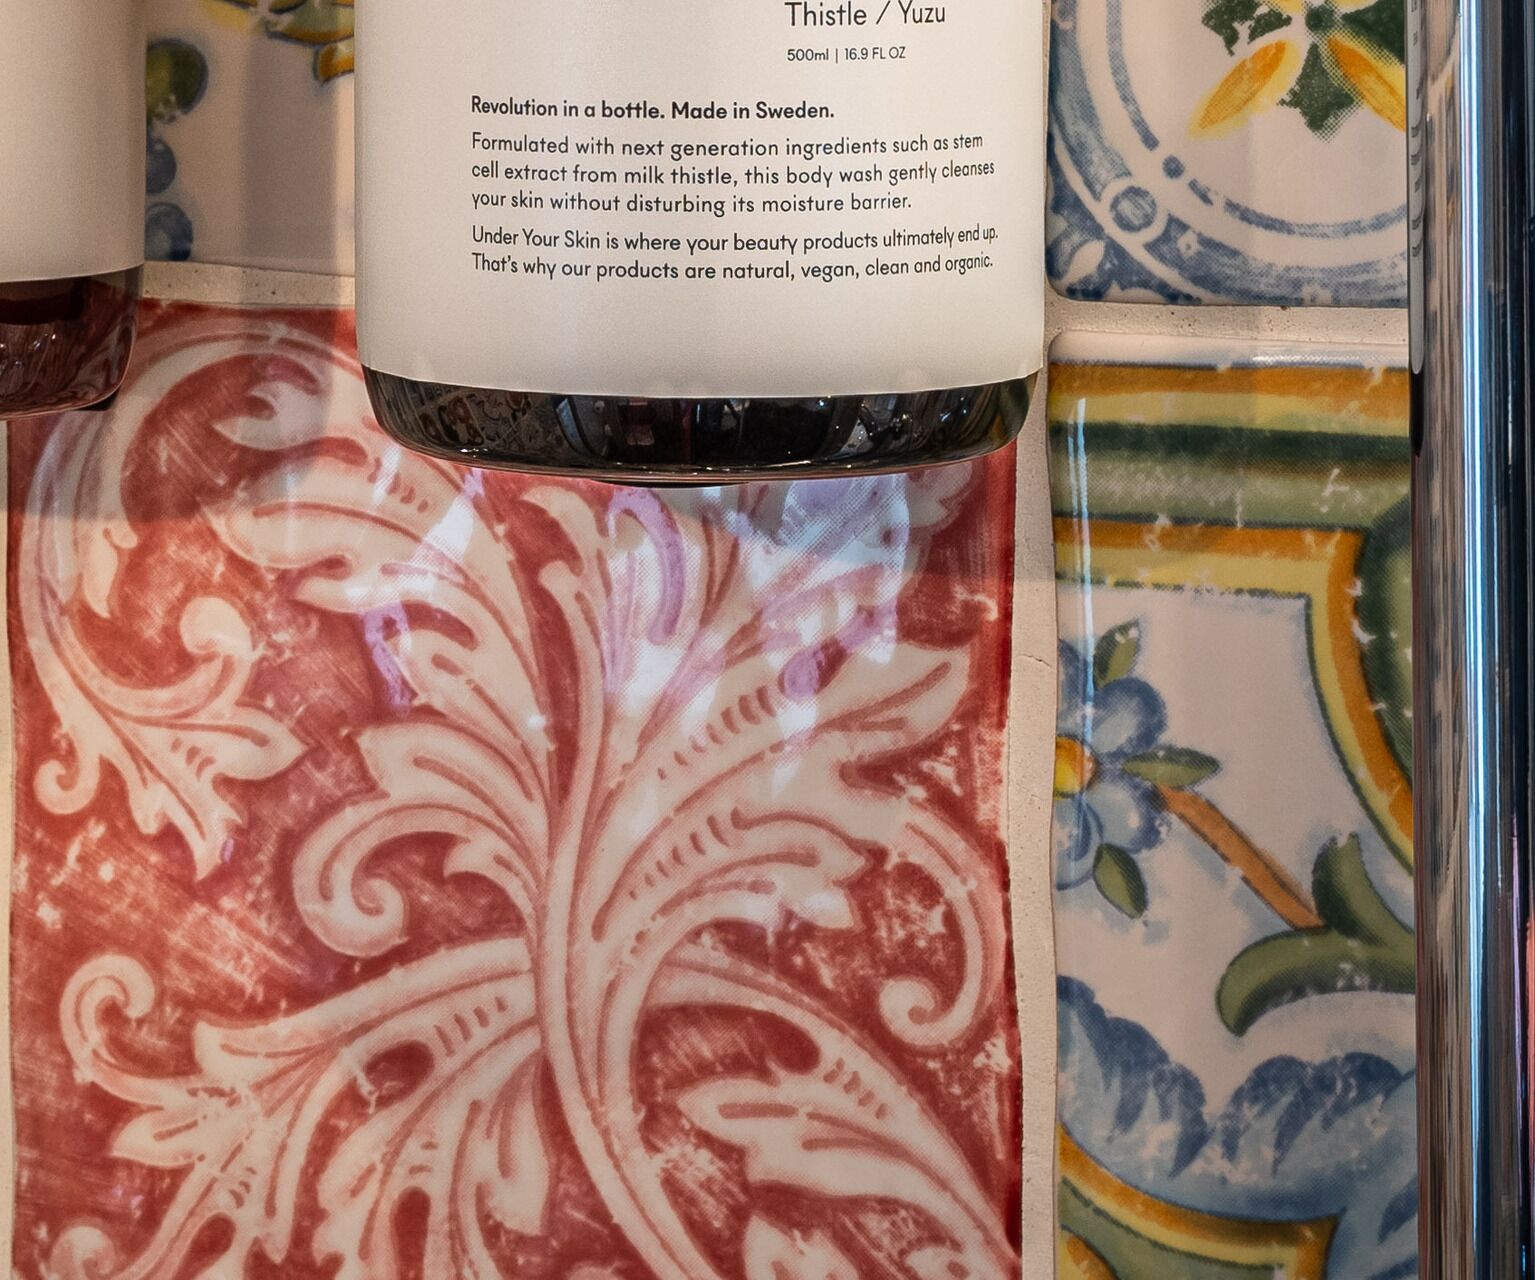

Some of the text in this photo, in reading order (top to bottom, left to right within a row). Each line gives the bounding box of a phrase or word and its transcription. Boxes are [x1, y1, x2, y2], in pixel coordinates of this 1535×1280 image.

[784, 0, 945, 26] Thistle / Yuzu
[787, 46, 906, 61] 500ml 16.9 FL OZ
[472, 95, 834, 119] Revolution in a bottle. Made in Sweden.
[472, 131, 887, 162] Formulated with next generation ingredients
[472, 160, 937, 188] cell extract from milk thistle, this body wash gently
[472, 189, 911, 218] your skin without disturbing its moisture barrier.
[473, 225, 878, 256] Under Your Skin where your beauty products
[471, 252, 941, 283] That's why our products are natural, vegan, clean and
